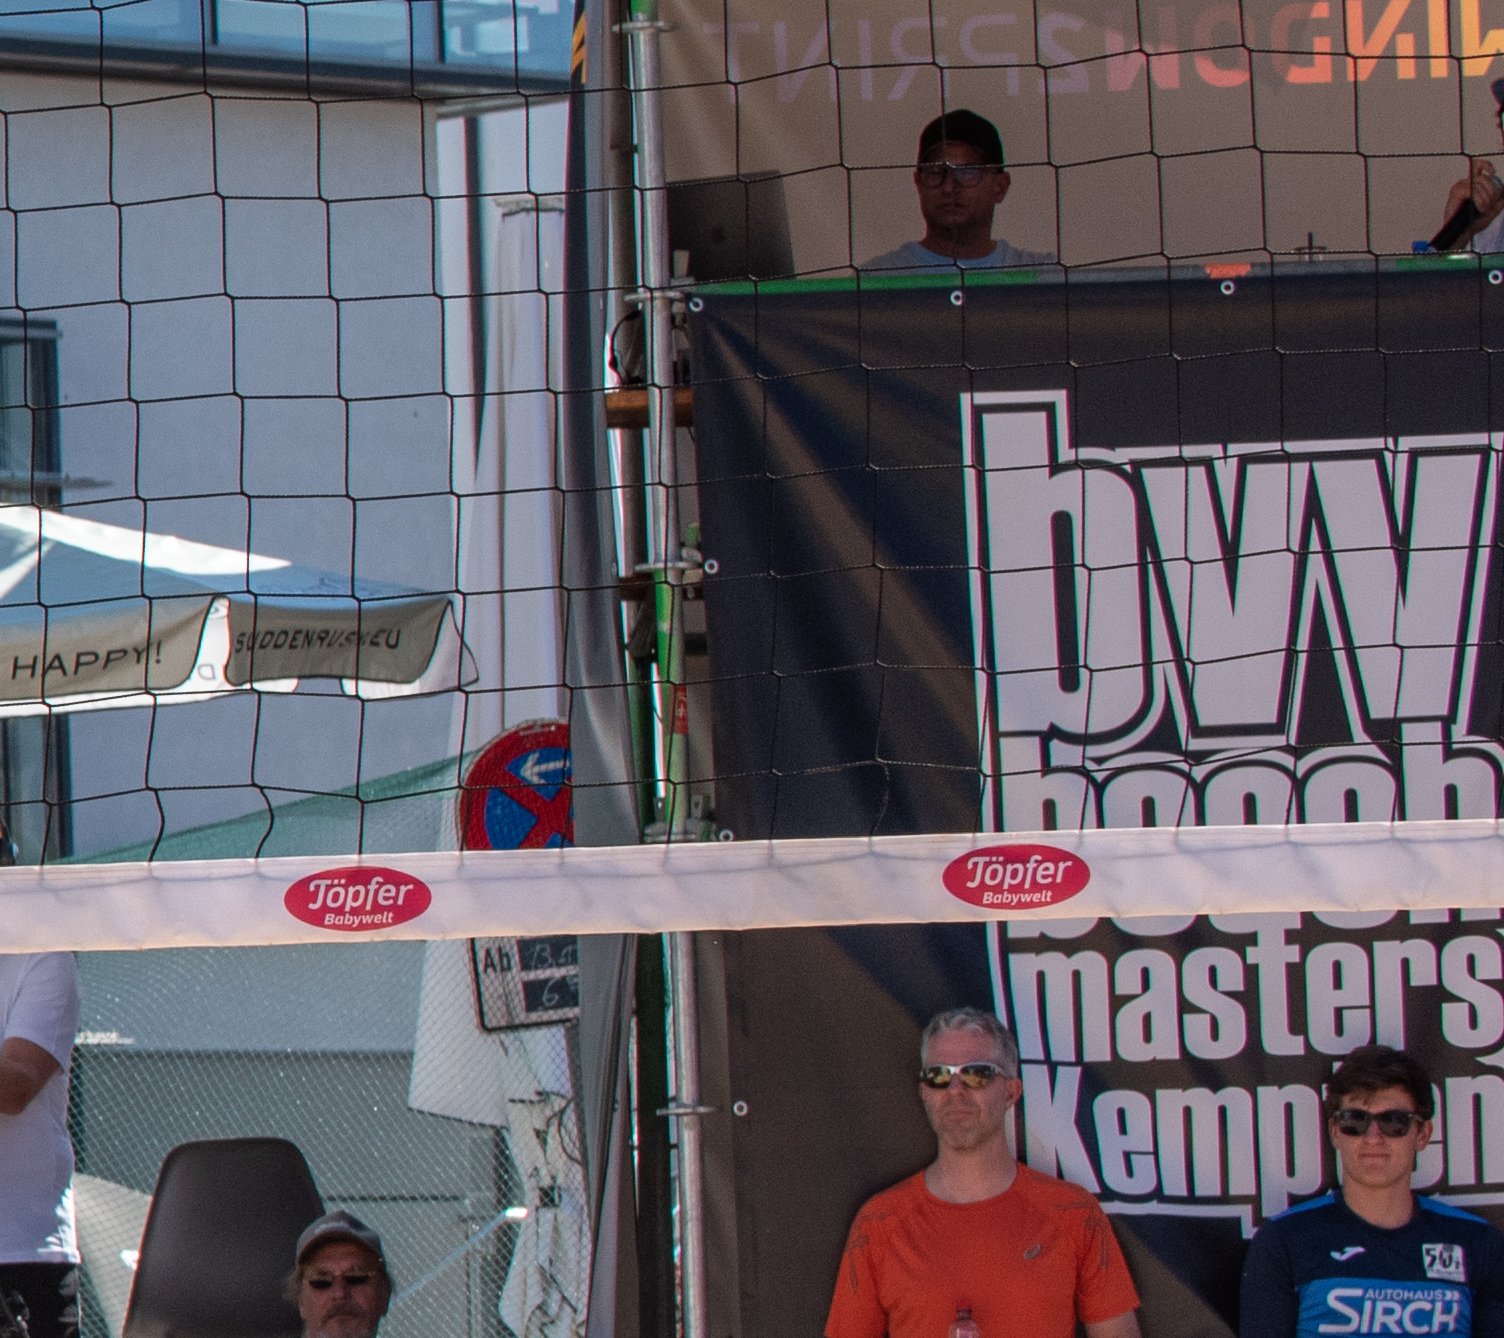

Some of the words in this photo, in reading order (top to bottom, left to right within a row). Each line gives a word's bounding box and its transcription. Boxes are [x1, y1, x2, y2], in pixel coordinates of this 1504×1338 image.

[10, 640, 164, 680] HAPPY!
[966, 854, 1072, 890] Töpfer
[308, 876, 413, 912] Töpfer
[982, 891, 1051, 905] Babywelt
[323, 912, 392, 926] Babywelt
[482, 944, 514, 974] Ab
[1008, 929, 1504, 1062] masters
[1317, 1287, 1460, 1335] SIRCH
[1364, 1288, 1445, 1302] AUTOHAUS
